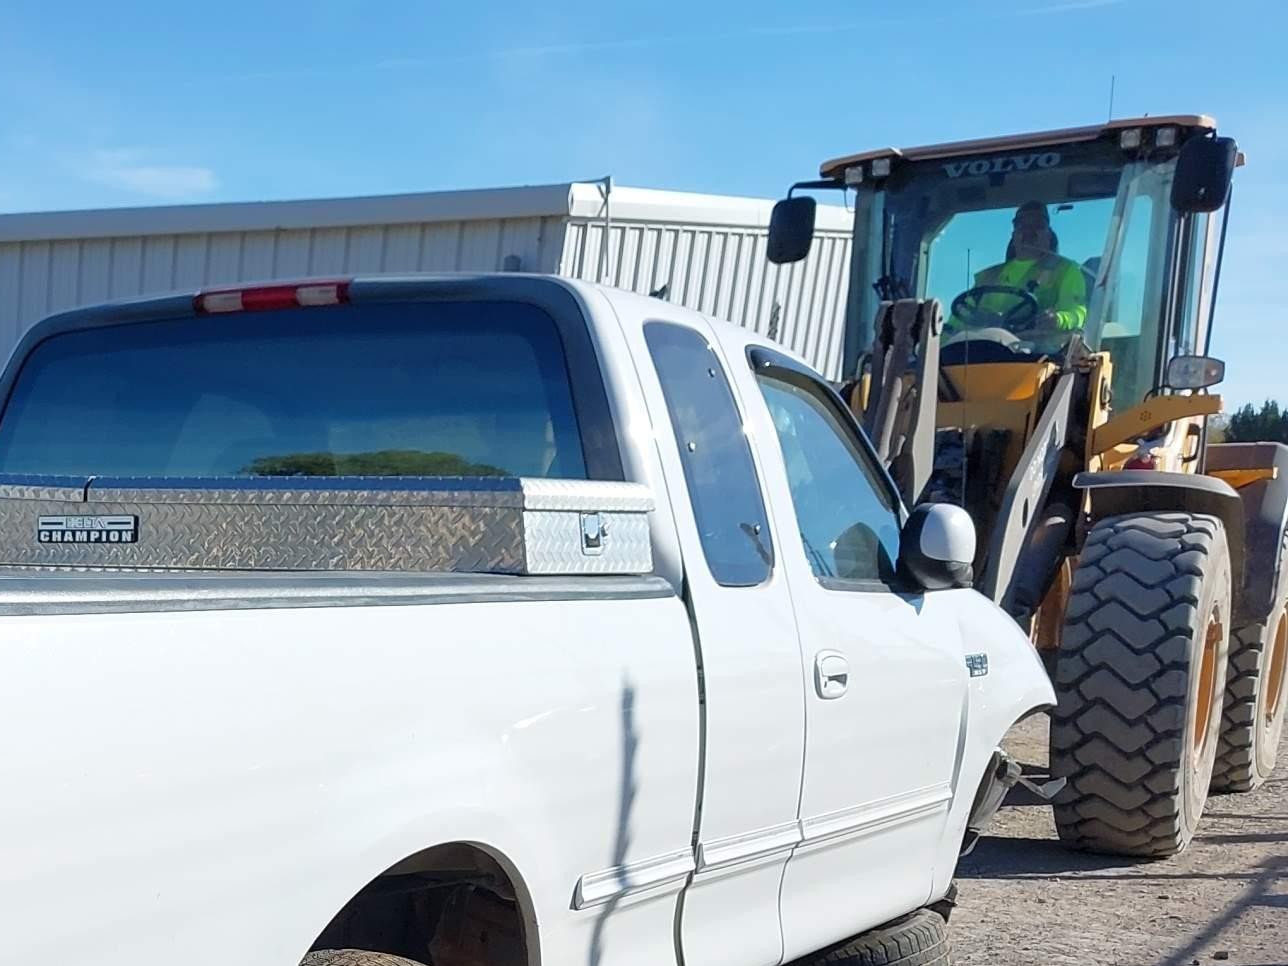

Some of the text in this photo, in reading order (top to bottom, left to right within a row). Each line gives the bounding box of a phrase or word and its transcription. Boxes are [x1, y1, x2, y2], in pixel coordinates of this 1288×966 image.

[942, 152, 1061, 178] VOLVO
[66, 517, 106, 529] DELTA
[39, 530, 133, 542] CHAMPION
